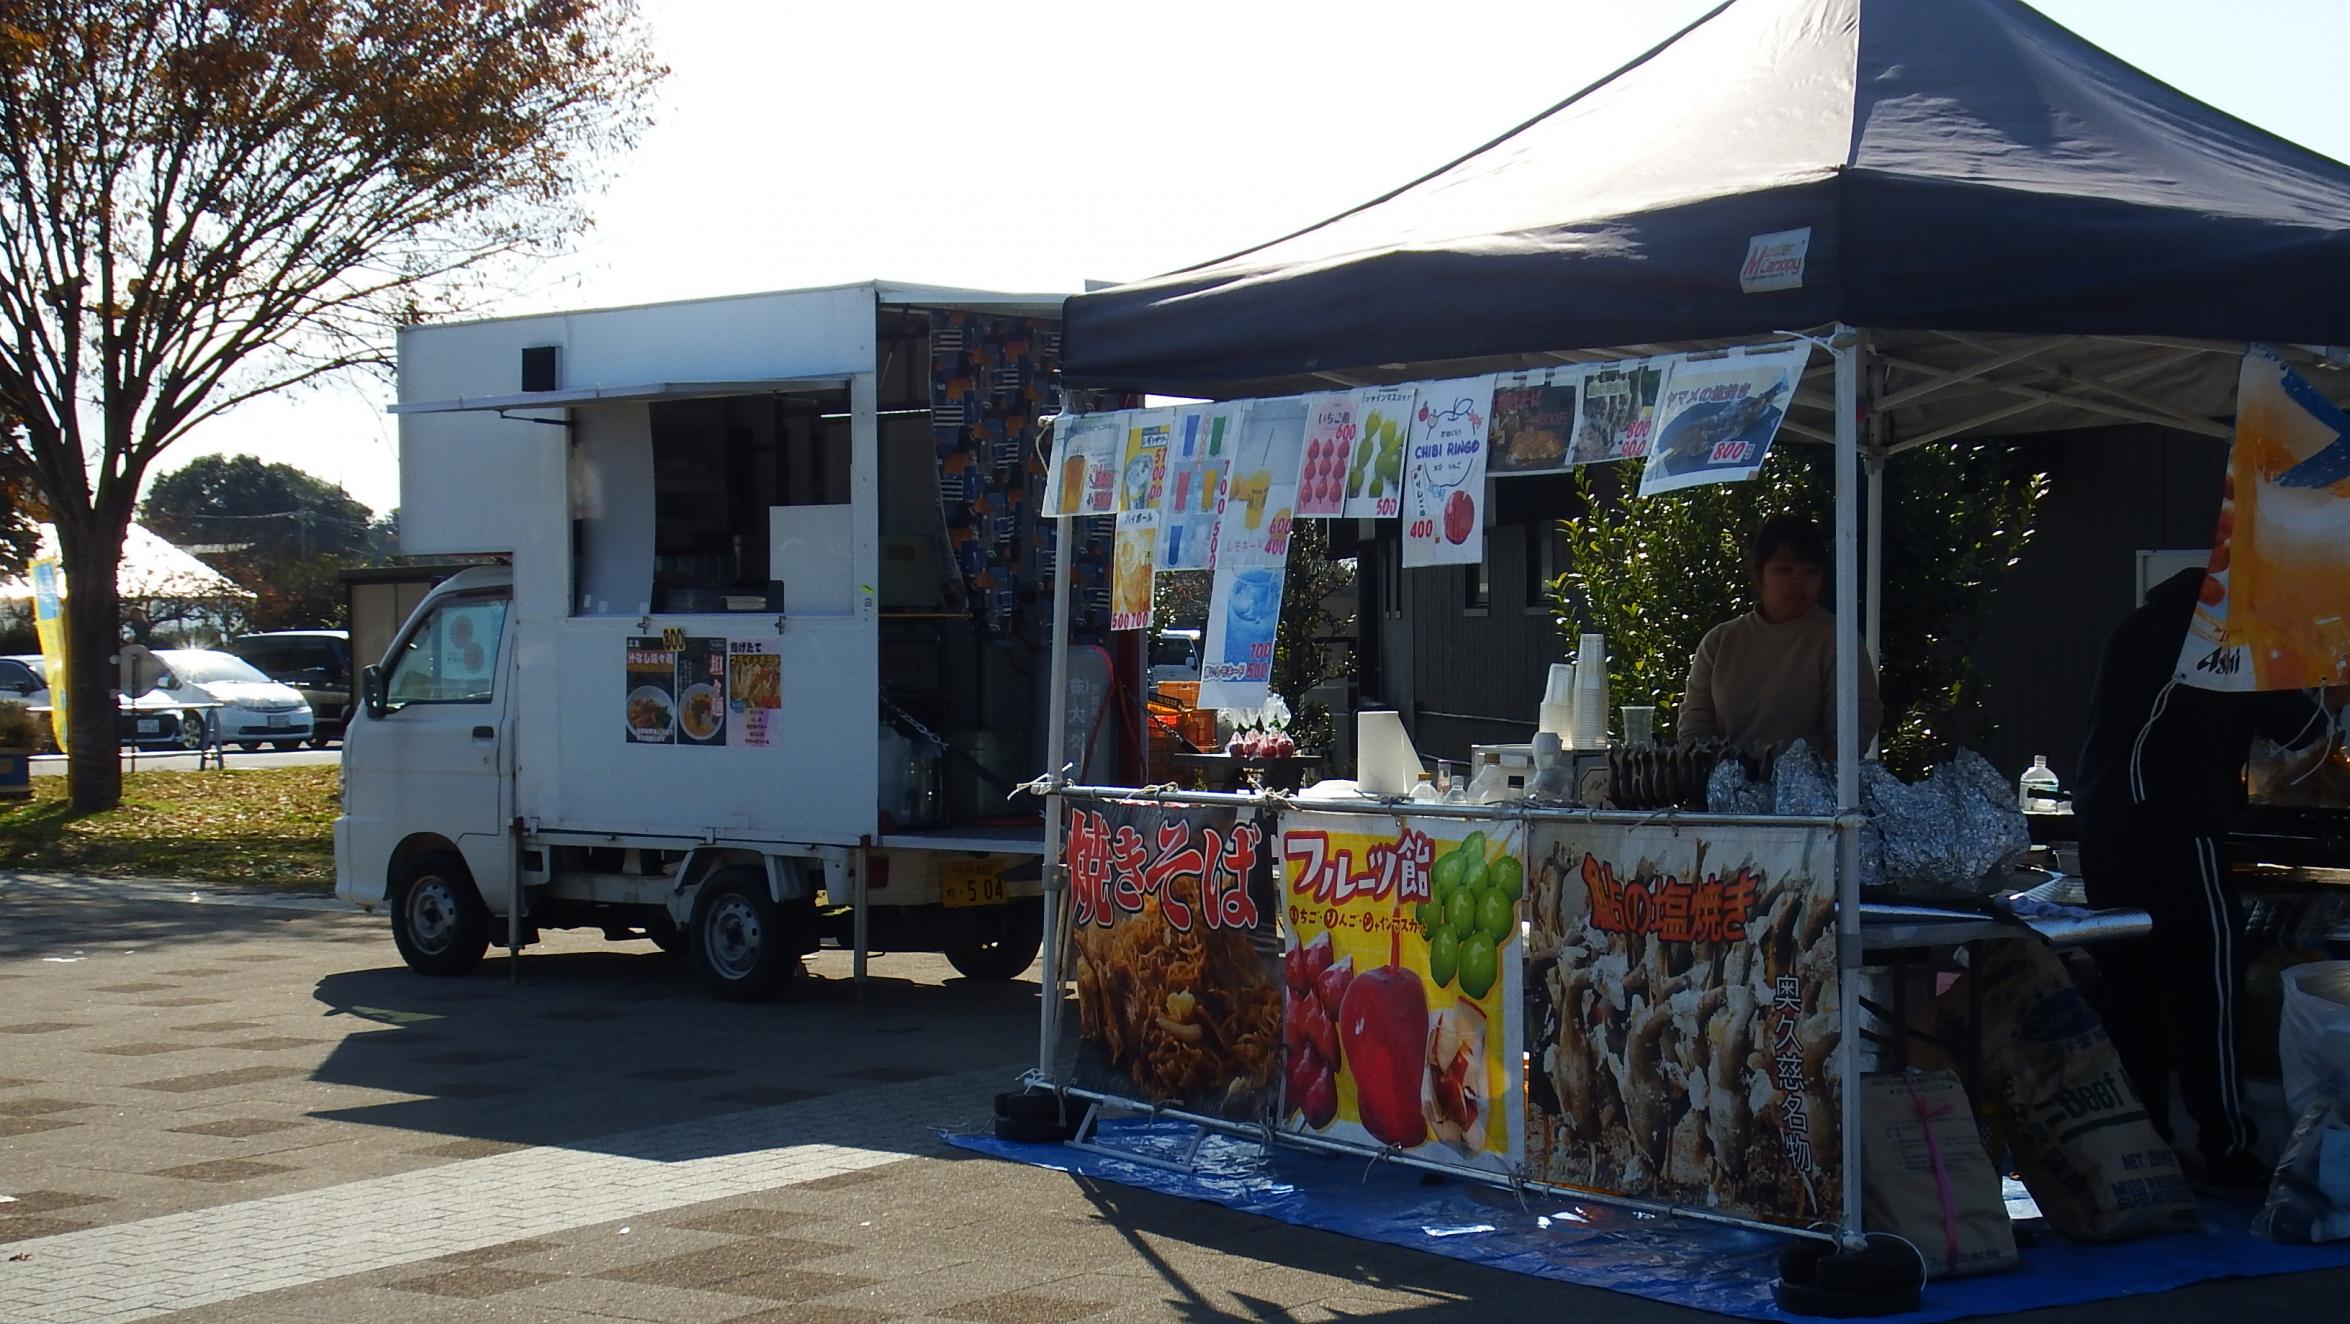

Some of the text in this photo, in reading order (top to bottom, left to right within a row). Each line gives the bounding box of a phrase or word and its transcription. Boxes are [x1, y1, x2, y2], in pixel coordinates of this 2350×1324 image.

[1336, 423, 1356, 440] 600
[1415, 439, 1480, 460] CHIBI RINGO
[1713, 442, 1745, 460] 800
[1376, 498, 1397, 516] 500
[1269, 517, 1293, 534] 600
[1410, 520, 1433, 538] 400
[1264, 538, 1287, 556] 400
[1112, 610, 1149, 628] 500 700
[1066, 808, 1262, 931] 焼きそば
[1284, 828, 1435, 904] フルーツ飴
[1581, 852, 1760, 943] 鮎の塩焼き
[1774, 974, 1812, 1173] 奥久慈名物
